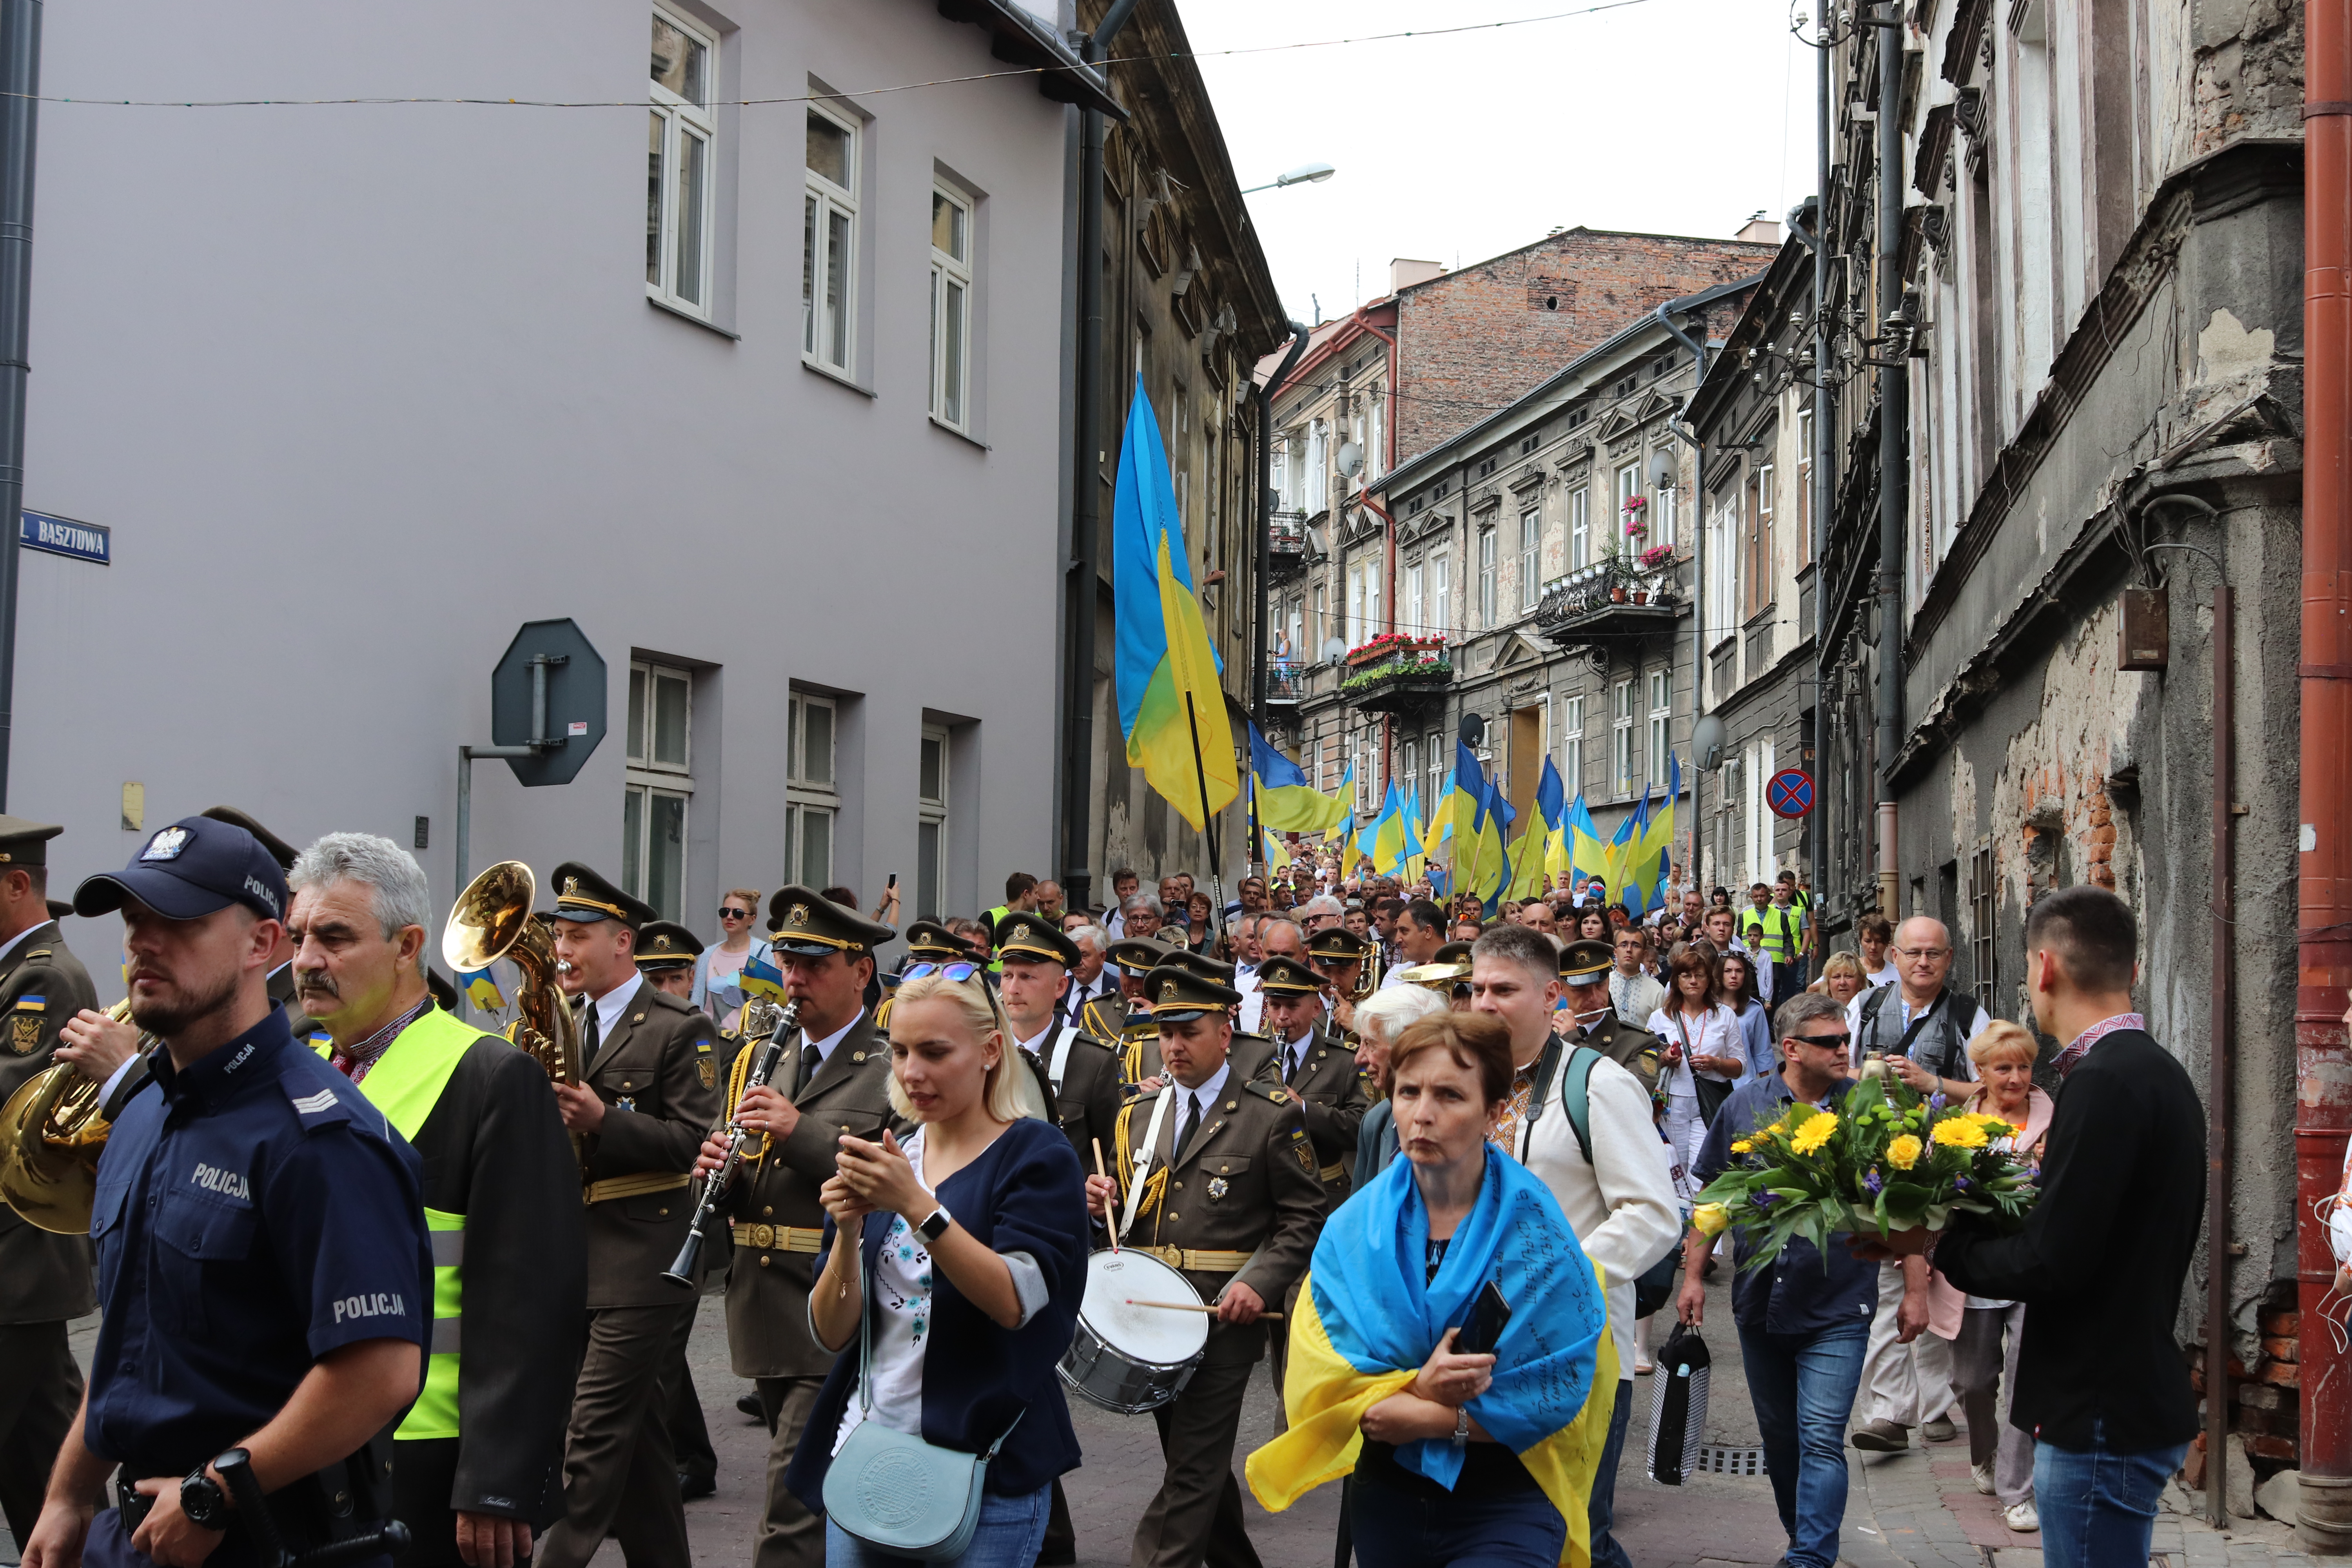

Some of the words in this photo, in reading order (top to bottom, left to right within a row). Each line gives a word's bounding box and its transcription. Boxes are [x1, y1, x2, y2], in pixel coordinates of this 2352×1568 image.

[21, 516, 29, 539] L.
[38, 520, 104, 555] BASZTOWA
[244, 875, 280, 918] POLICJA
[1213, 875, 1222, 909] CENTAURUS
[223, 1044, 256, 1075] POLICJA
[191, 1163, 250, 1201] POLICJA
[332, 1293, 406, 1324] POLICJA
[484, 1496, 510, 1506] Galant
